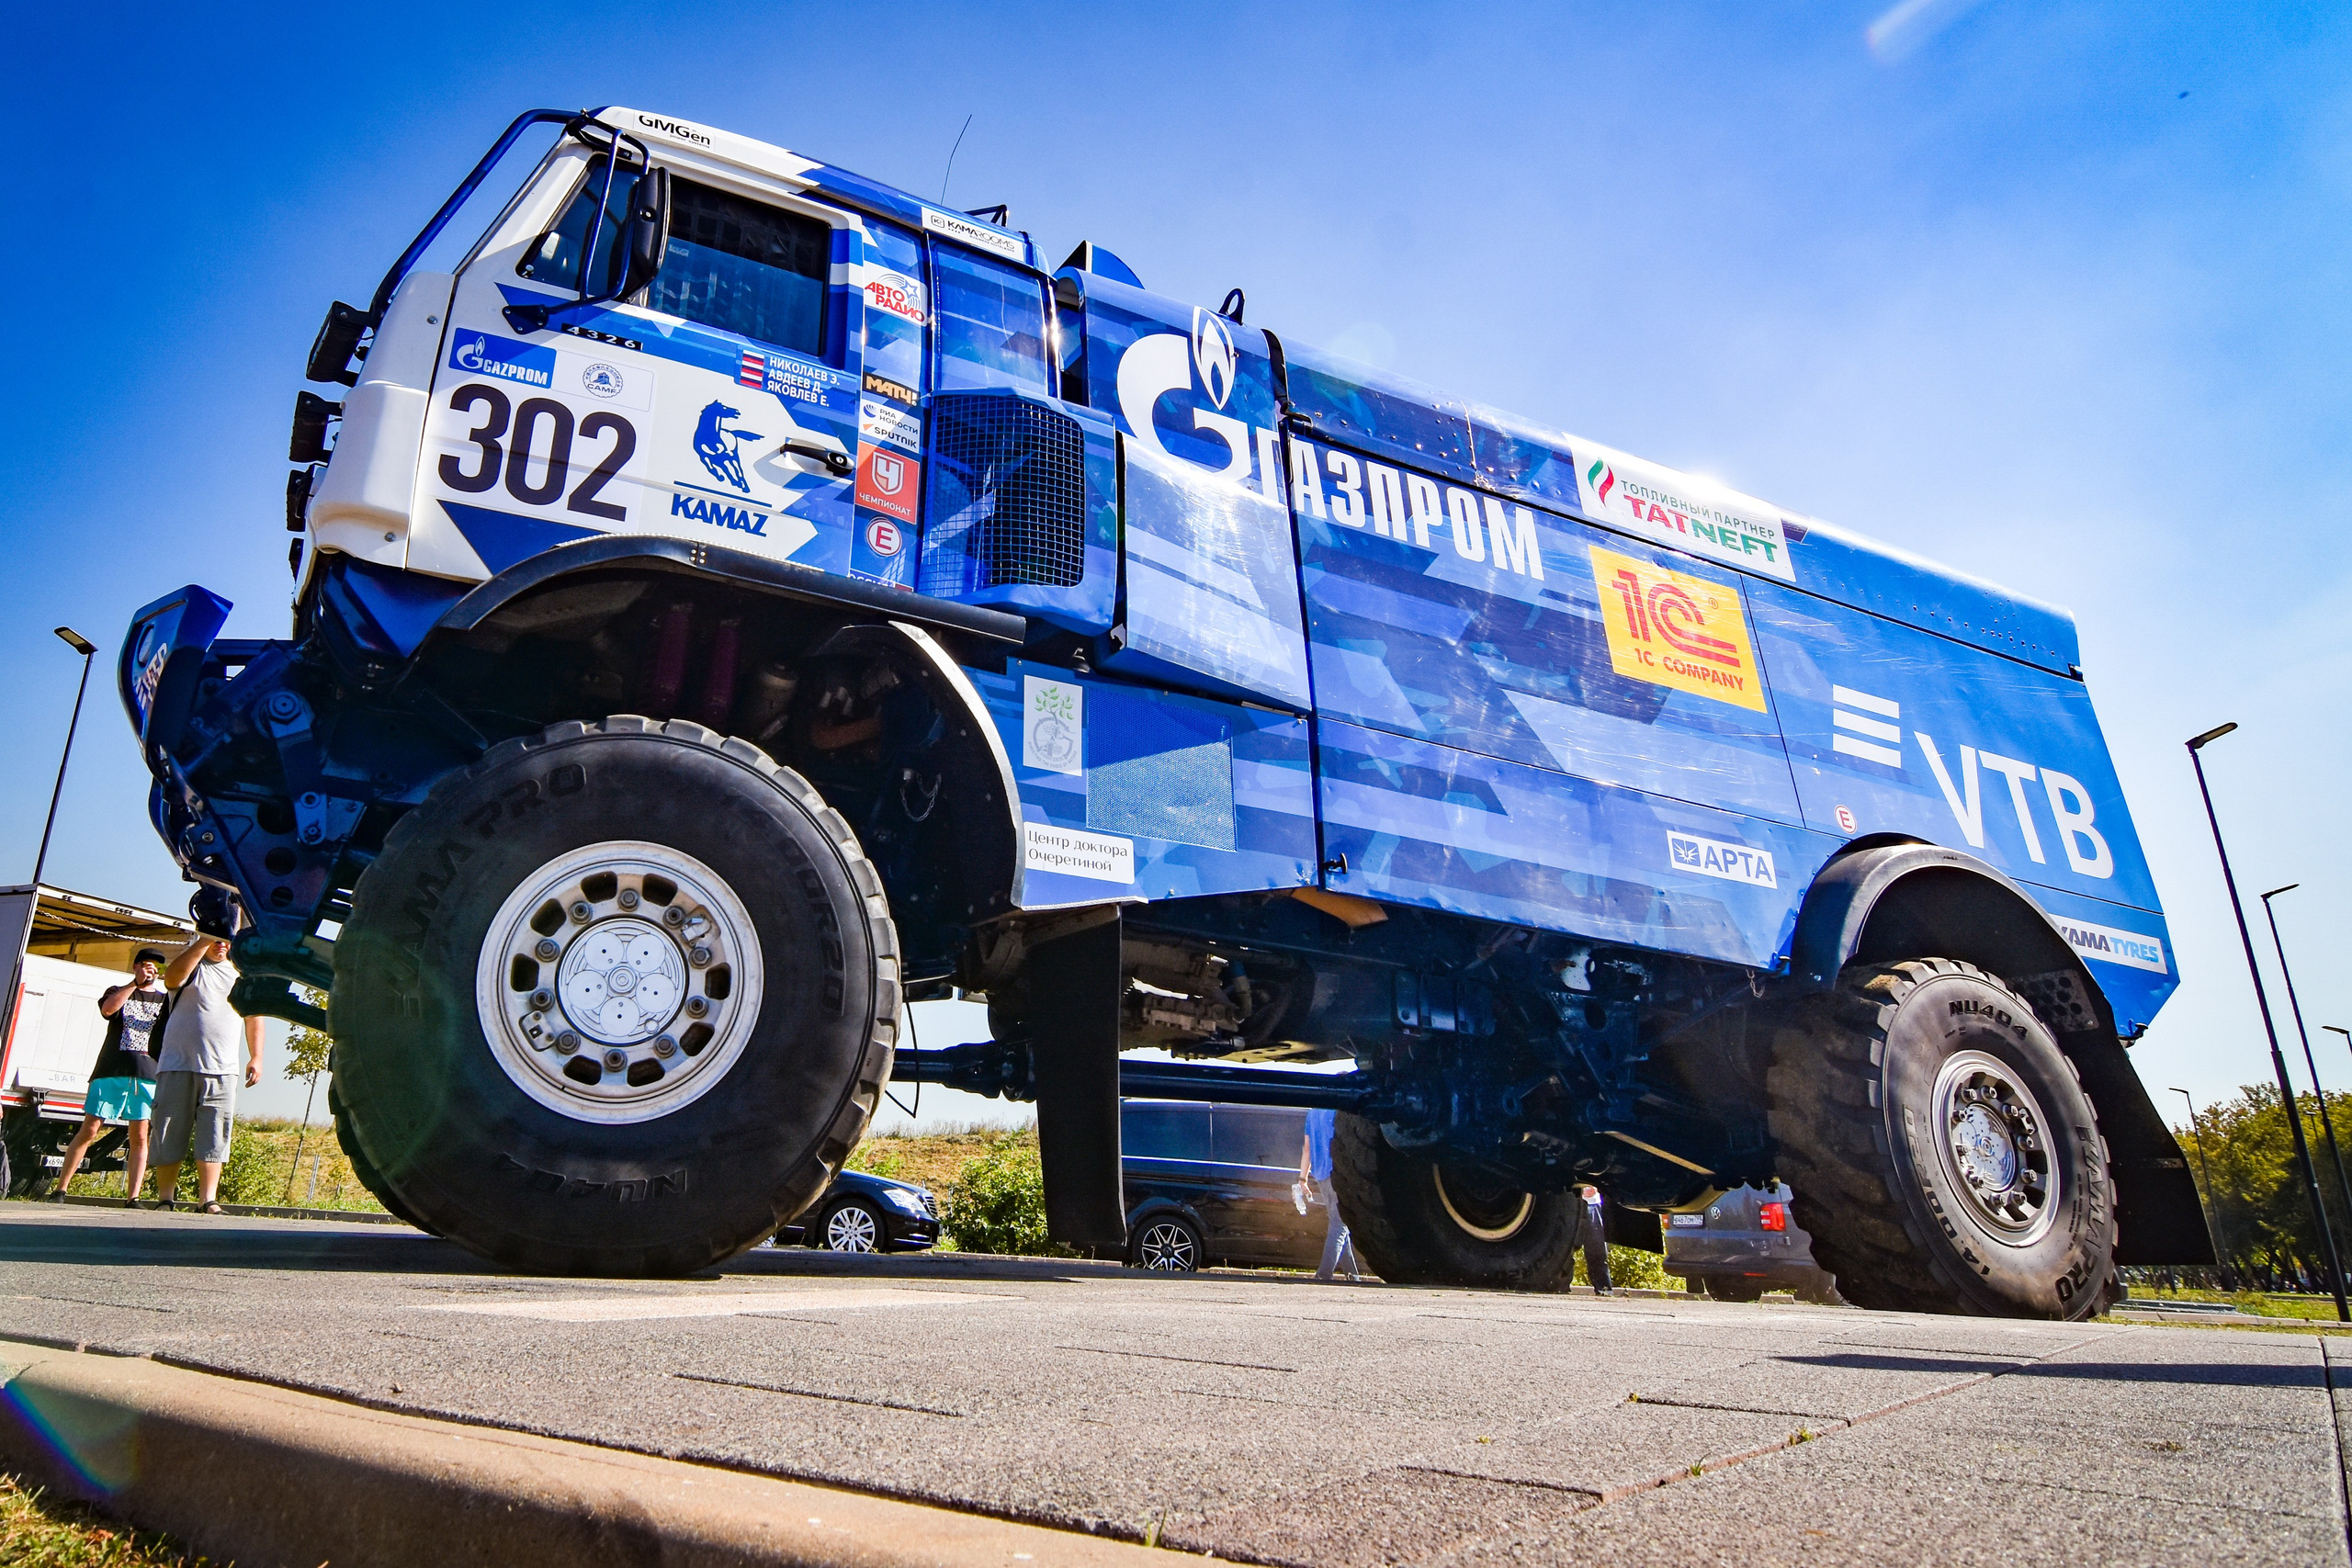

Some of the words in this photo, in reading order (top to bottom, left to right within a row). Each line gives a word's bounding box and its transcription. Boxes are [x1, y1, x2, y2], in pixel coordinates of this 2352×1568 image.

[639, 115, 710, 145] GMGen
[947, 220, 1015, 250] KAMAROOMS
[865, 281, 905, 302] АВТО
[876, 294, 925, 322] РАДИО
[482, 359, 548, 385] GAZPROM
[768, 368, 810, 389] АВДЕЕВ
[812, 381, 823, 393] Д.
[769, 356, 828, 381] НИКОЛАЕВ
[830, 374, 840, 386] Э.
[767, 380, 818, 403] ЯКОВЛЕВ
[820, 395, 830, 407] Е.
[865, 375, 918, 406] МАТЧ!
[879, 416, 919, 434] НОВОСТИ
[880, 409, 896, 419] РИА
[874, 426, 917, 448] SPUTNIK
[438, 384, 636, 522] 302
[671, 493, 768, 537] KAMAZ
[859, 491, 911, 516] ЧЕМПИОНАТ
[1256, 425, 1545, 582] ГАЗПРОМ
[1621, 479, 1710, 519] ТОПЛИВНЫЙ
[1714, 512, 1775, 540] ПАРТНЕР
[1623, 494, 1778, 563] TATNEFT
[1663, 656, 1744, 691] COMPANY
[1914, 730, 2113, 879] VTB
[1027, 829, 1069, 849] Центр
[1073, 841, 1128, 858] доктора
[1028, 848, 1112, 872] Очеретиной
[1949, 999, 2028, 1041] NU404
